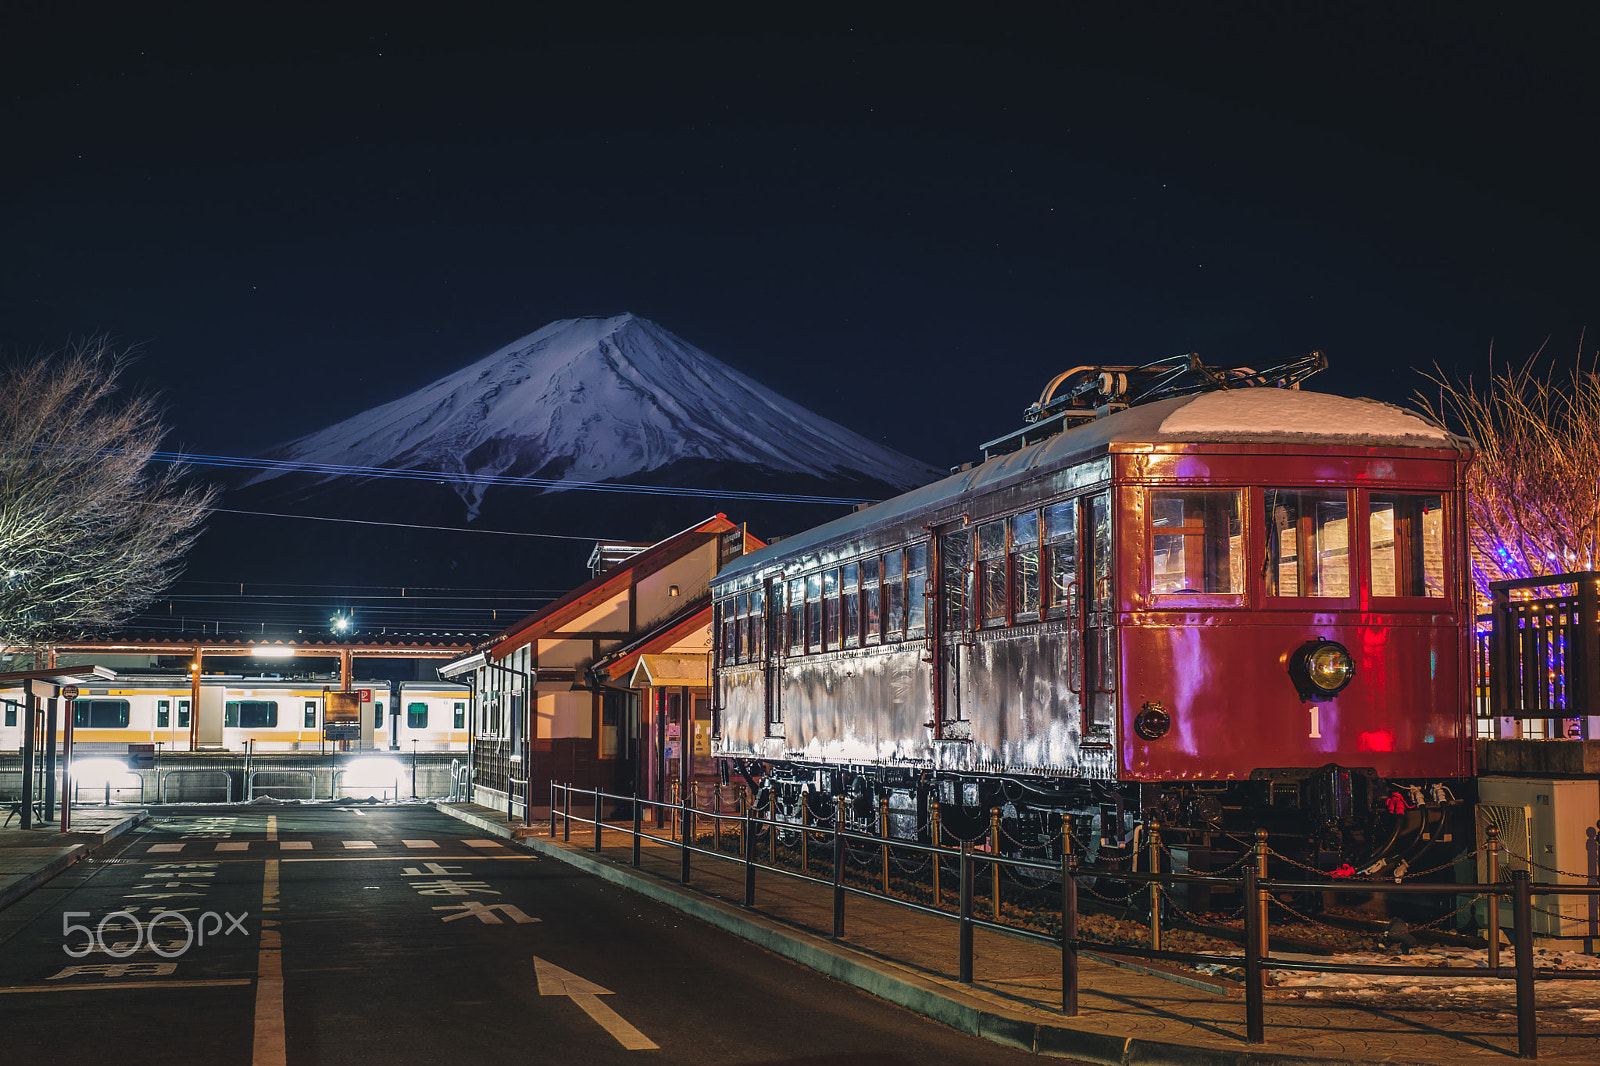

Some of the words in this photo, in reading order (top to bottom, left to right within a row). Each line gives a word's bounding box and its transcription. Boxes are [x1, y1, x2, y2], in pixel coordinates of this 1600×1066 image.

[1309, 706, 1321, 738] 1
[400, 863, 543, 924] 止まれ
